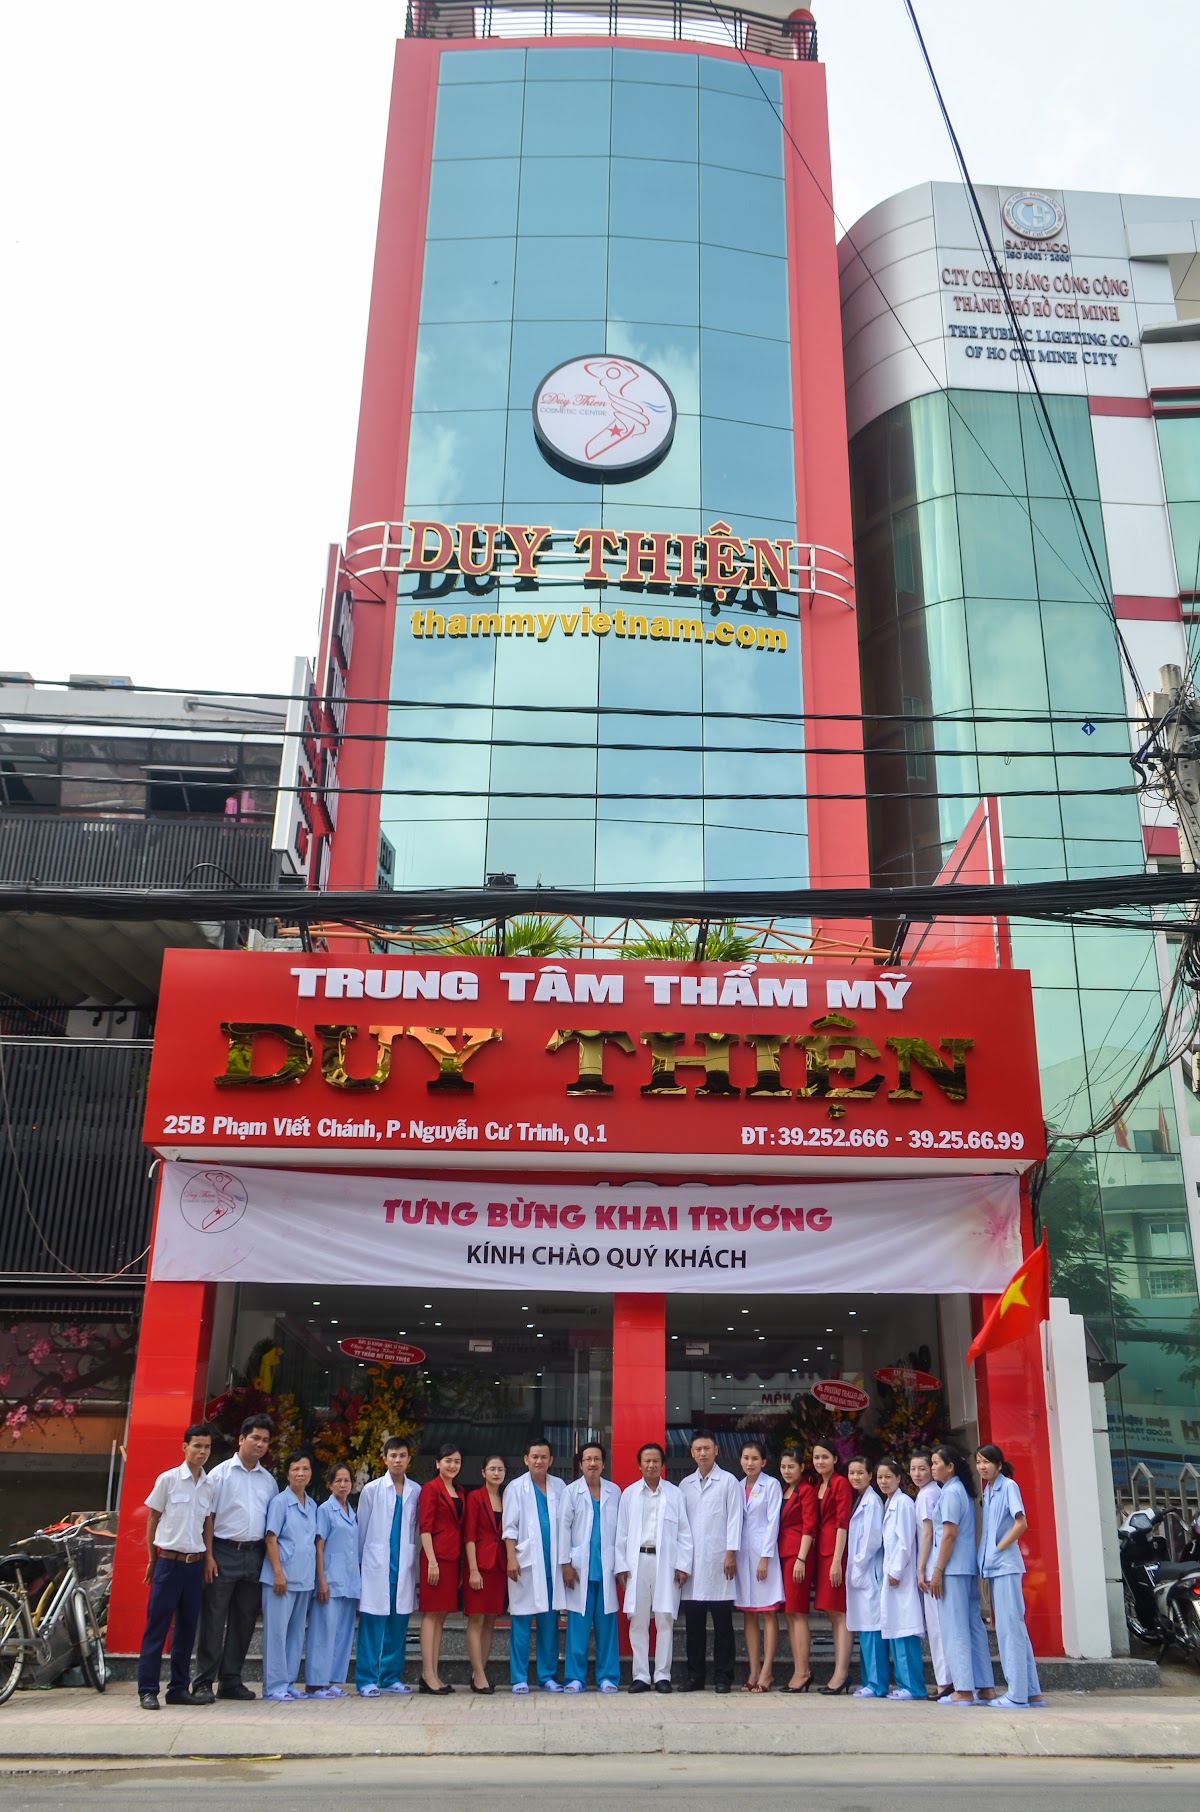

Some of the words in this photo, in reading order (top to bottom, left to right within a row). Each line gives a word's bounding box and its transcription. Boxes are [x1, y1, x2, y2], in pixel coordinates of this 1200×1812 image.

[1005, 240, 1069, 253] SAPULICO
[1006, 251, 1022, 260] ISO
[1015, 269, 1051, 292] SÁNG
[1053, 272, 1090, 295] CÔNG
[1093, 274, 1129, 298] CỘNG
[953, 293, 1002, 314] THÀNH
[1032, 294, 1052, 318] HỒ
[1055, 299, 1080, 319] CHÍ
[1081, 304, 1120, 322] MINH
[949, 324, 978, 338] THE
[1036, 329, 1107, 346] LIGHTING
[1110, 334, 1133, 347] CO.
[965, 345, 983, 358] OF
[986, 346, 1007, 360] HO
[1038, 349, 1078, 364] MINH
[1082, 351, 1118, 366] CITY
[540, 407, 577, 415] COSMETIC
[541, 392, 570, 408] Duy
[403, 519, 553, 577] DUY
[573, 519, 794, 602] THIỆN
[411, 606, 788, 651] thammyvietnam.com
[290, 967, 479, 1001] TRUNG
[499, 965, 624, 1004] TÂM
[644, 964, 808, 1008] THẨM
[826, 972, 912, 1010] MỸ
[213, 1021, 503, 1092] DUY
[545, 1012, 976, 1121] THIỆN
[162, 1115, 205, 1134] 25B
[212, 1115, 267, 1140] Phạm
[273, 1115, 311, 1137] Viết
[317, 1117, 383, 1142] Chánh,
[485, 1121, 512, 1141] Cư
[517, 1122, 570, 1146] Trinh,
[573, 1123, 607, 1146] Q.1
[908, 1129, 1025, 1151] 39.25.66.99
[382, 1198, 479, 1226] TƯNG
[486, 1196, 586, 1230] BỪNG
[594, 1205, 678, 1231] KHAI
[688, 1204, 833, 1232] TRƯƠNG
[467, 1240, 525, 1264] KÍNH
[532, 1243, 600, 1266] CHÀO
[606, 1244, 659, 1269] QUÝ
[664, 1245, 747, 1269] KHÁCH
